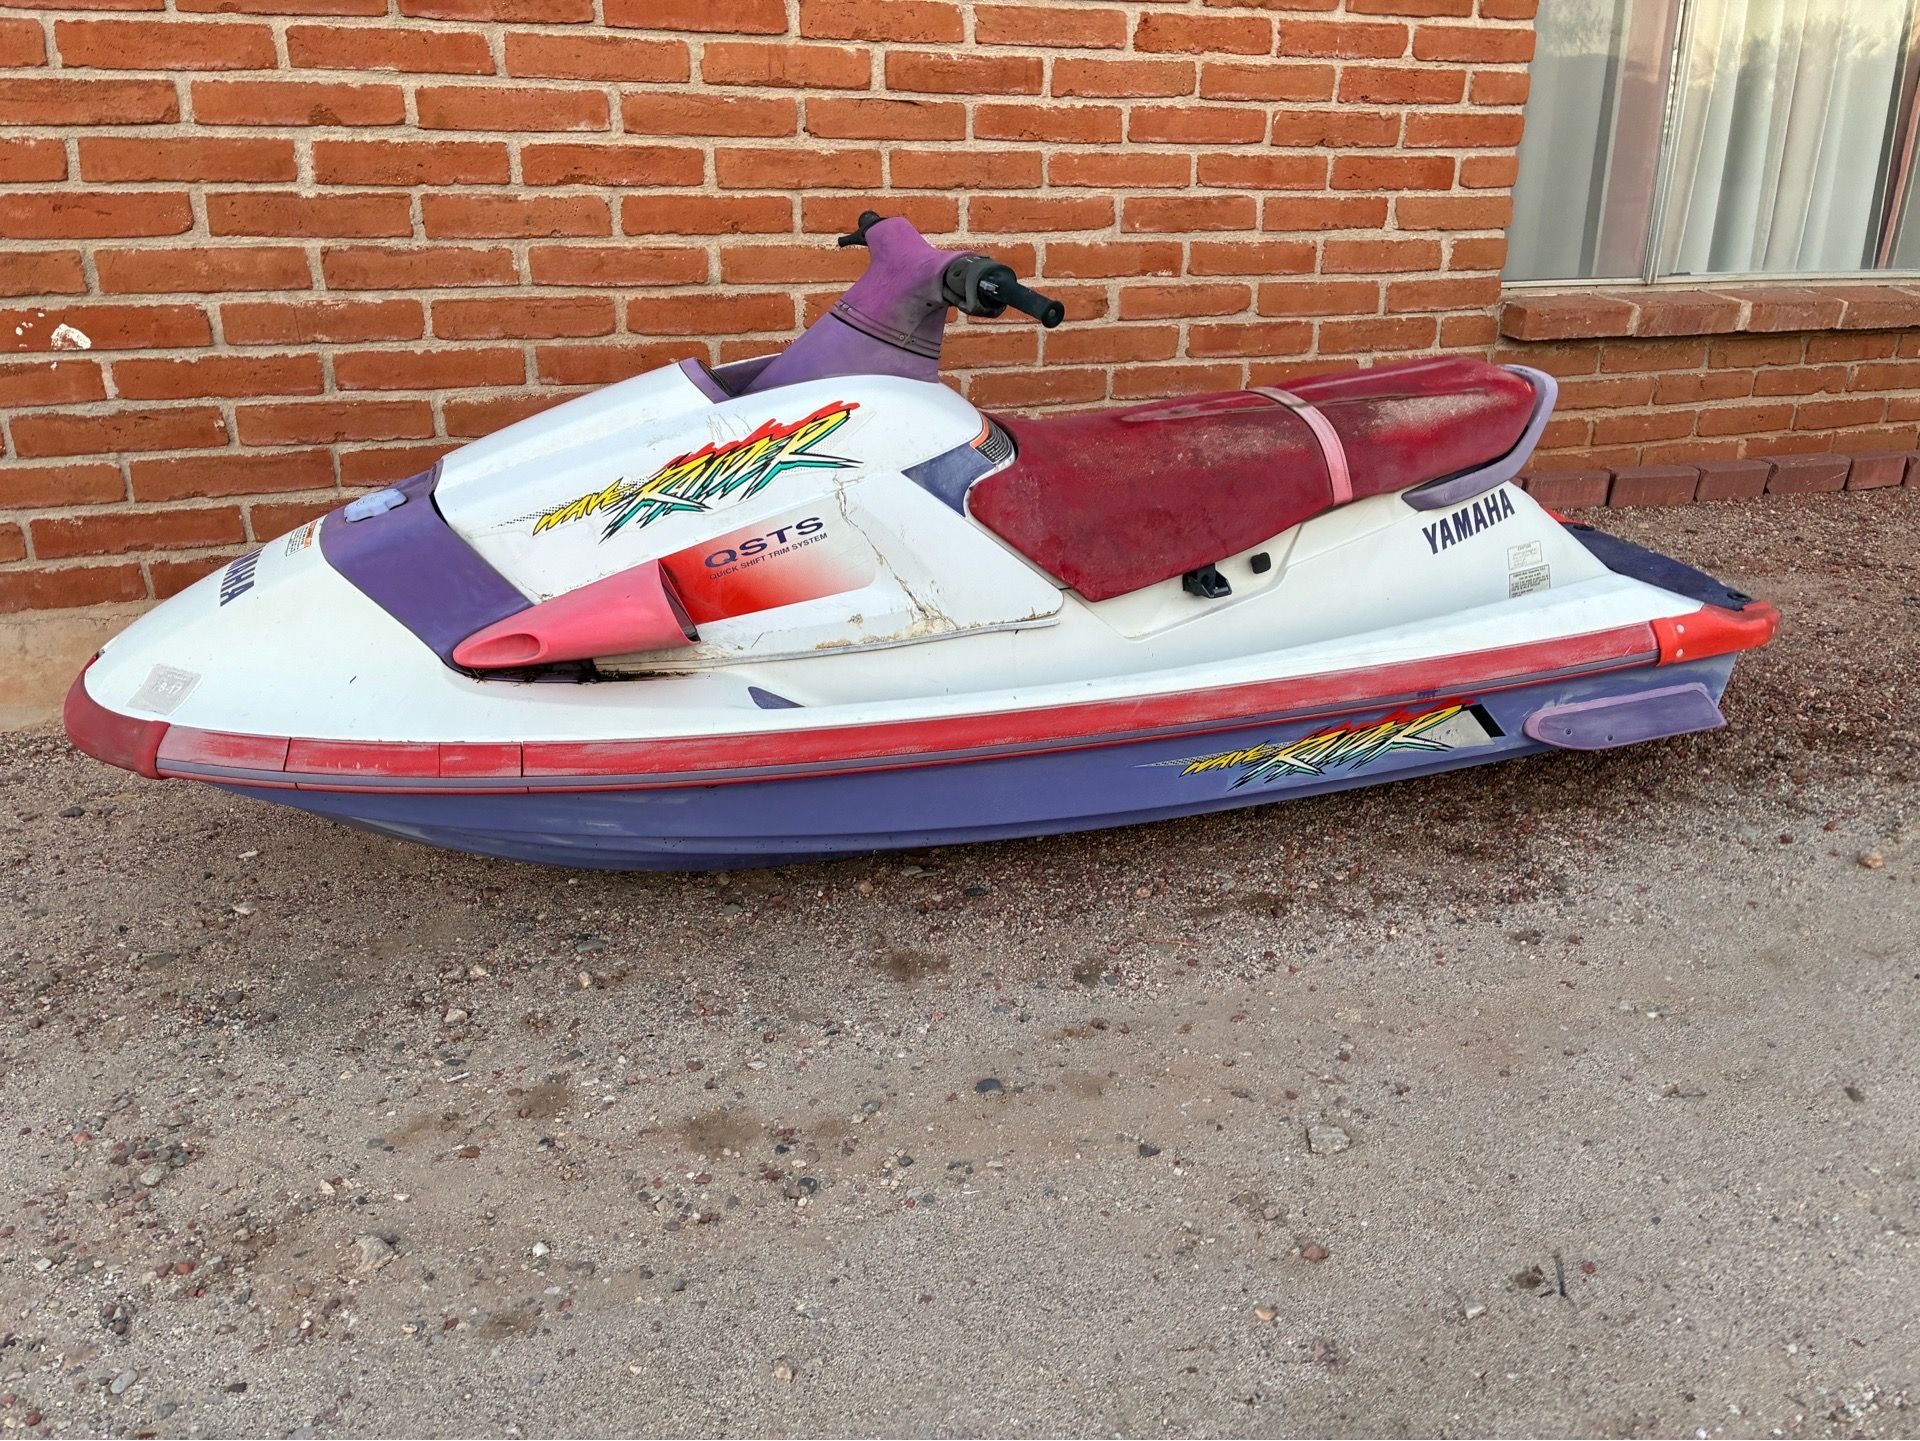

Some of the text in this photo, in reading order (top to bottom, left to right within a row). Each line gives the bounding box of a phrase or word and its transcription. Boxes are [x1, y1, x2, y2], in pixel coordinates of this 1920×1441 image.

[533, 408, 864, 544] WAVE RAIDER
[704, 517, 824, 569] QSTS
[1421, 488, 1516, 555] YAMAHA
[709, 532, 828, 580] QUICK SHIFT TRIM SYSTEM
[1178, 704, 1465, 792] WAVE RAIDER
